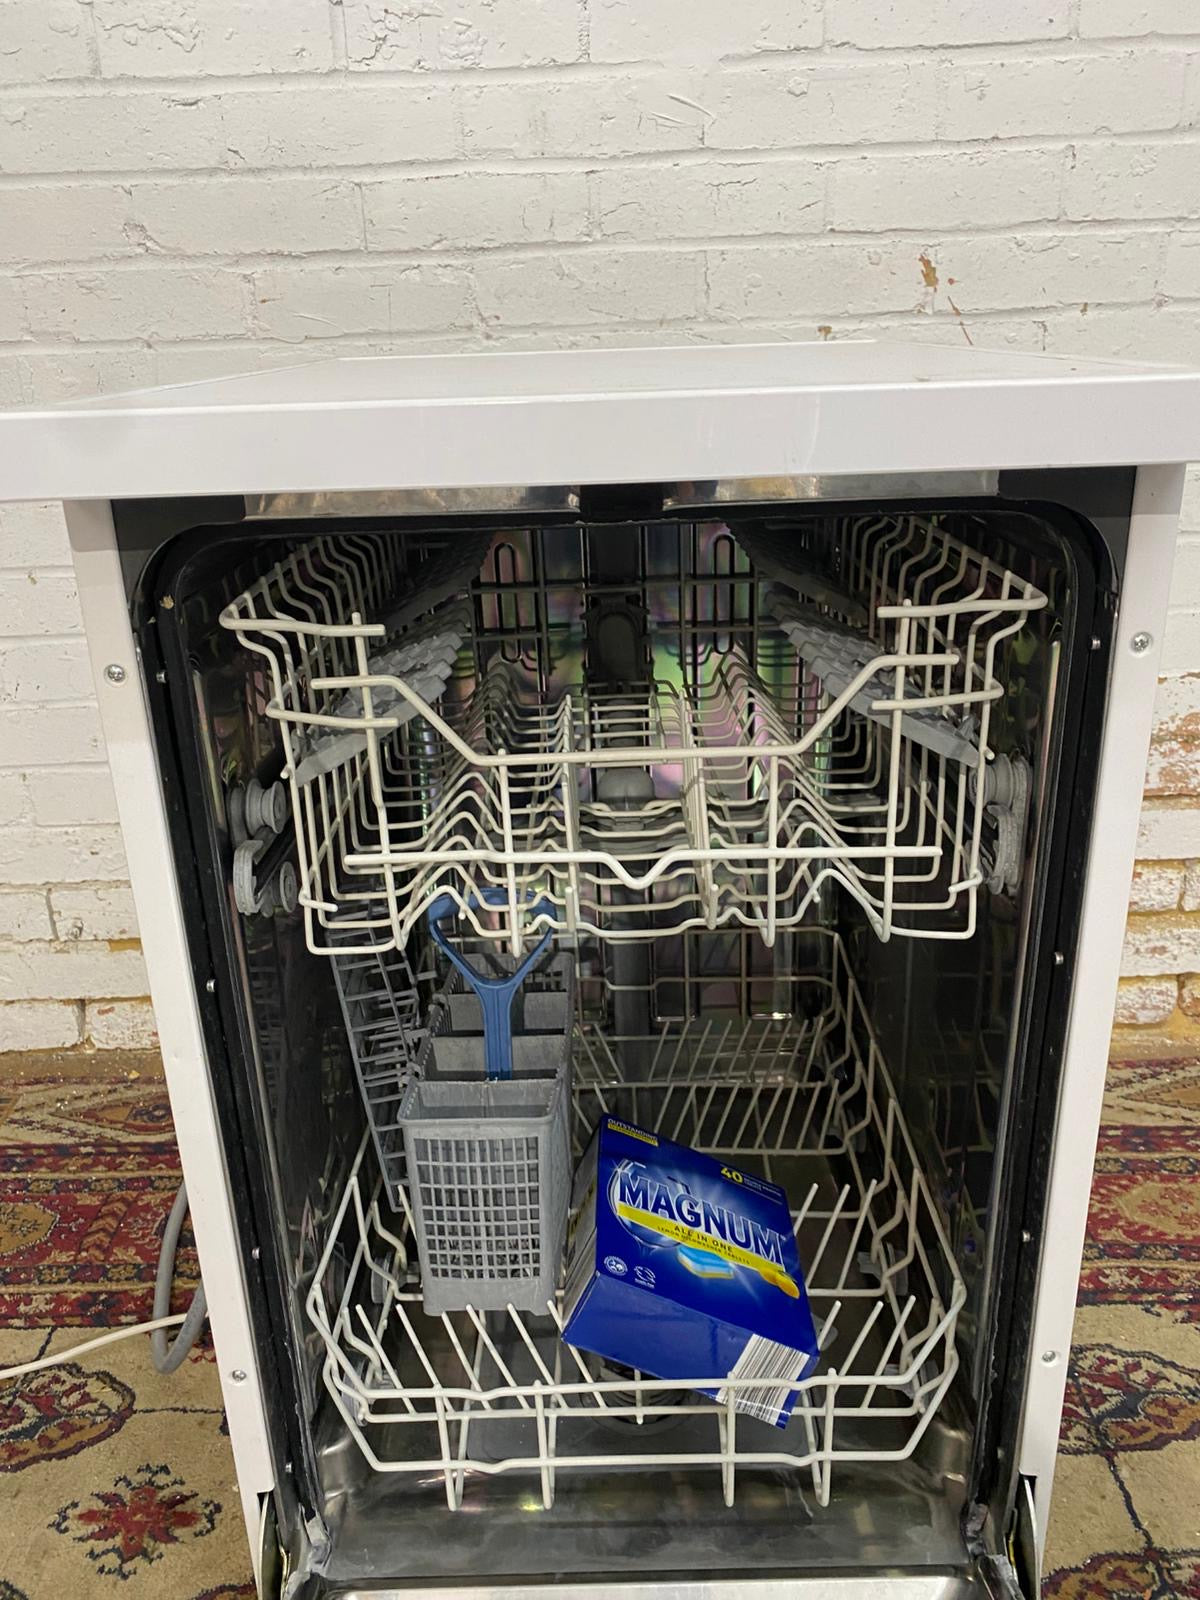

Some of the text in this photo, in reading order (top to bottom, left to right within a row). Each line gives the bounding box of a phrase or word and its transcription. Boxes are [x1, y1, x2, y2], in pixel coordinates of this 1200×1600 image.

[720, 1167, 743, 1184] 40
[618, 1170, 785, 1271] MAGNUM
[697, 1232, 709, 1242] IN
[712, 1239, 733, 1252] ONE
